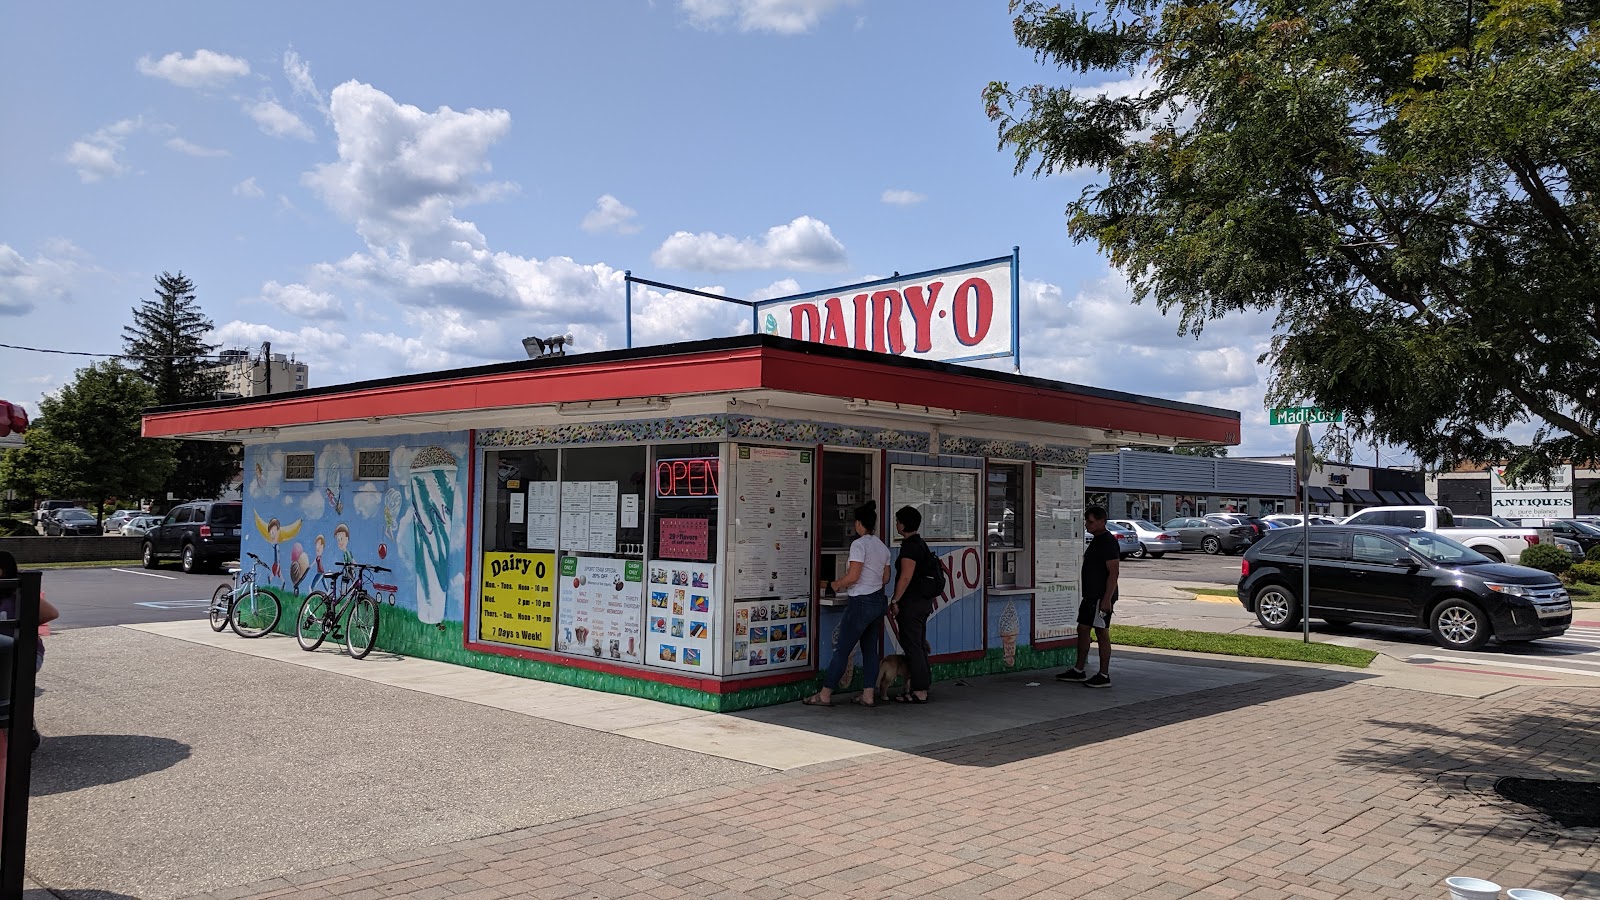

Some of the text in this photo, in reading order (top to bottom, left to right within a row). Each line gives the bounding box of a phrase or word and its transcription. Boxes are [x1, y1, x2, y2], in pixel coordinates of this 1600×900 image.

[658, 460, 719, 496] OPEN
[1493, 498, 1572, 507] ANTIQUES
[491, 554, 546, 578] Dairy O
[492, 627, 496, 635] 7
[498, 627, 513, 639] Days
[522, 630, 542, 641] Week!
